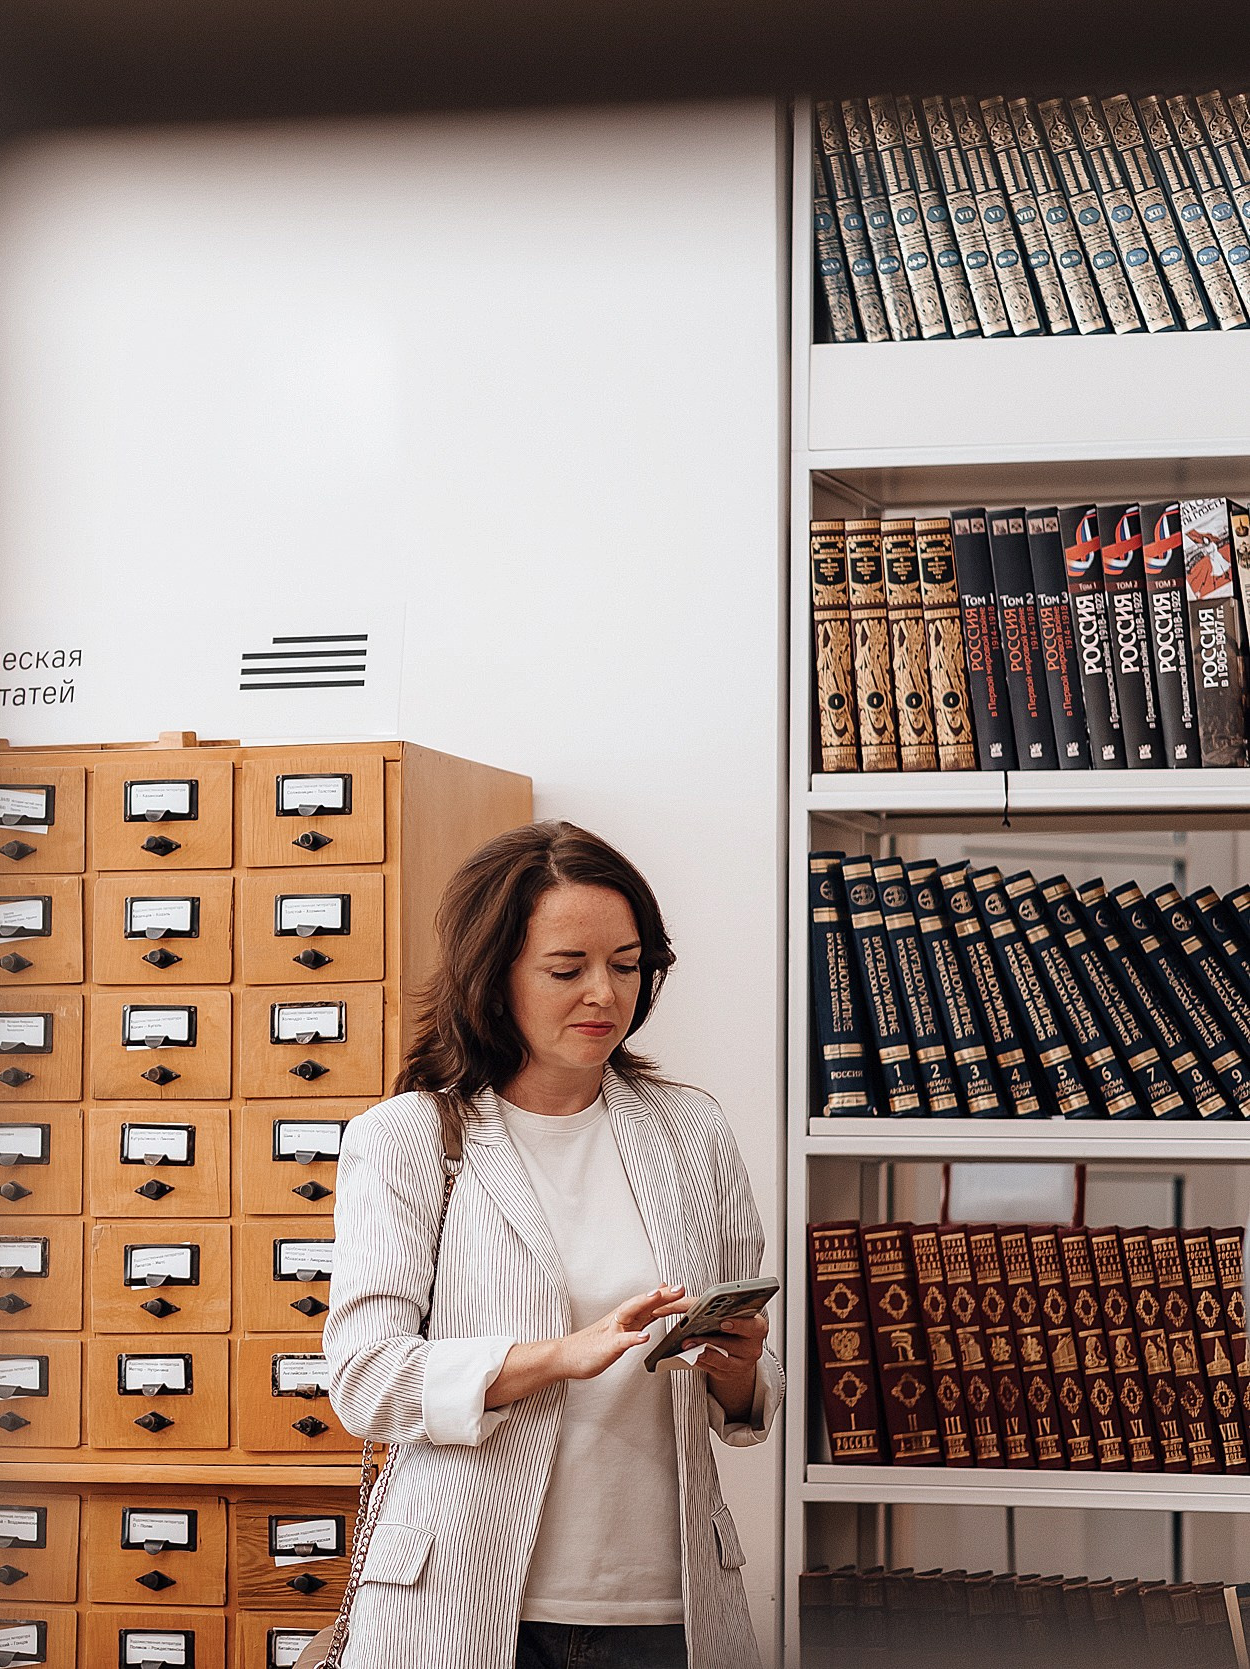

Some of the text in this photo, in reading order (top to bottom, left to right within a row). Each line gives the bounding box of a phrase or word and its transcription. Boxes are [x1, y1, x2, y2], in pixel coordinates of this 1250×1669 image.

[873, 216, 885, 225] III
[900, 211, 911, 222] IV
[958, 210, 973, 221] VII
[988, 210, 1001, 220] VI
[1016, 209, 1035, 221] VIII
[1050, 210, 1063, 220] IX
[1146, 208, 1163, 220] XII
[1182, 206, 1201, 220] XIII
[1093, 581, 1097, 589] 1
[1171, 579, 1177, 587] 3
[962, 592, 995, 607] Том 1
[1000, 593, 1034, 607] Том 2
[1037, 592, 1069, 607] Том 3
[979, 607, 989, 634] войне
[1019, 607, 1028, 634] войне
[1053, 606, 1062, 633] войне
[965, 607, 983, 672] РОССИЯ
[1003, 608, 1023, 672] РОССИЯ
[1040, 607, 1060, 671] РОССИЯ
[1076, 595, 1103, 675] РОССИЯ
[1114, 594, 1140, 674] РОССИЯ
[1152, 593, 1177, 674] РОССИЯ
[982, 636, 993, 675] мировой
[1021, 636, 1032, 675] мировой
[1056, 635, 1067, 674] мировой
[1198, 608, 1219, 688] РОССИЯ
[1221, 679, 1229, 687] в
[986, 676, 998, 711] Первой
[1025, 676, 1037, 711] Первой
[1060, 675, 1072, 711] Первой
[862, 937, 888, 1037] БОЛЬШАЯ РОССИЙСКАЯ
[872, 936, 900, 1035] ЭНЦИКЛОПЕДИЯ
[896, 939, 924, 1037] БОЛЬШАЯ РОССИЙСКАЯ
[906, 937, 937, 1035] ЭНЦИКЛОПЕДИЯ
[931, 940, 963, 1039] БОЛЬШАЯ РОССИЙСКАЯ
[941, 939, 975, 1036] ЭНЦИКЛОПЕДИЯ
[966, 945, 1002, 1043] БОЛЬШАЯ РОССИЙСКАЯ
[976, 941, 1014, 1040] ЭНЦИКЛОПЕДИЯ
[1004, 945, 1046, 1041] БОЛЬШАЯ РОССИЙСКАЯ
[1013, 941, 1058, 1038] ЭНЦИКЛОПЕДИЯ
[1050, 946, 1099, 1040] ЭНЦИКЛОПЕДИЯ
[1040, 949, 1088, 1044] БОЛЬШАЯ РОССИЙСКАЯ
[830, 1070, 863, 1080] РОССИЯ
[893, 1064, 901, 1078] 1
[930, 1064, 940, 1079] 2
[970, 1065, 980, 1080] 3
[1011, 1068, 1021, 1082] 4
[1057, 1065, 1068, 1080] 5
[1101, 1066, 1112, 1081] 6
[1146, 1067, 1155, 1082] 7
[1191, 1068, 1203, 1083] 8
[1231, 1068, 1242, 1083] 9
[945, 1415, 961, 1434] III
[974, 1415, 992, 1434] III
[1005, 1416, 1019, 1435] IV
[1036, 1416, 1051, 1436] IV
[1071, 1418, 1081, 1436] V
[1099, 1419, 1114, 1438] VI
[1129, 1419, 1145, 1437] VI
[1160, 1420, 1179, 1437] VII
[1188, 1422, 1206, 1441] VII
[1218, 1422, 1240, 1441] VIII
[836, 1435, 874, 1451] РОССИЯ
